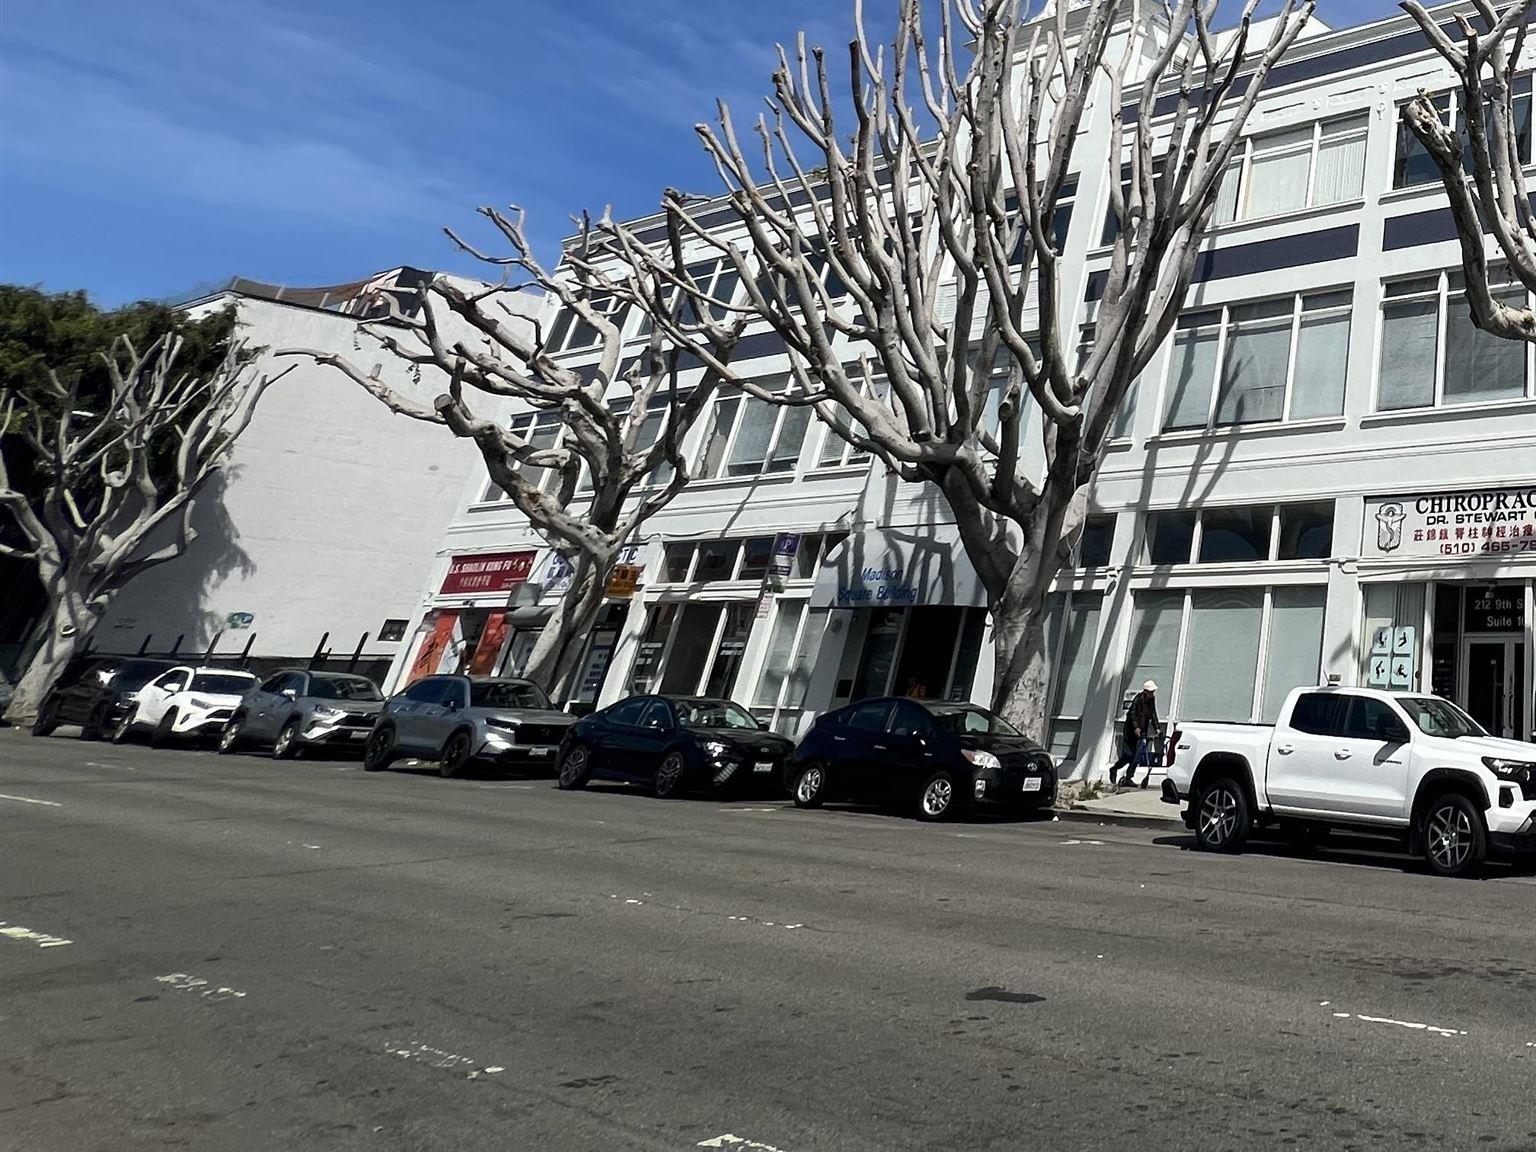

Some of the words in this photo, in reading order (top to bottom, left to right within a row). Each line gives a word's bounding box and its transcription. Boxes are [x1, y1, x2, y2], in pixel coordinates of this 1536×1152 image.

[1426, 515, 1448, 526] DR.
[1455, 511, 1527, 524] STEWART
[1440, 542, 1475, 555] (510)
[862, 567, 903, 581] Madison
[838, 587, 872, 604] Square
[877, 585, 917, 603] Building
[1475, 599, 1491, 610] 212
[1495, 599, 1512, 610] 9th
[1487, 616, 1512, 627] Suite
